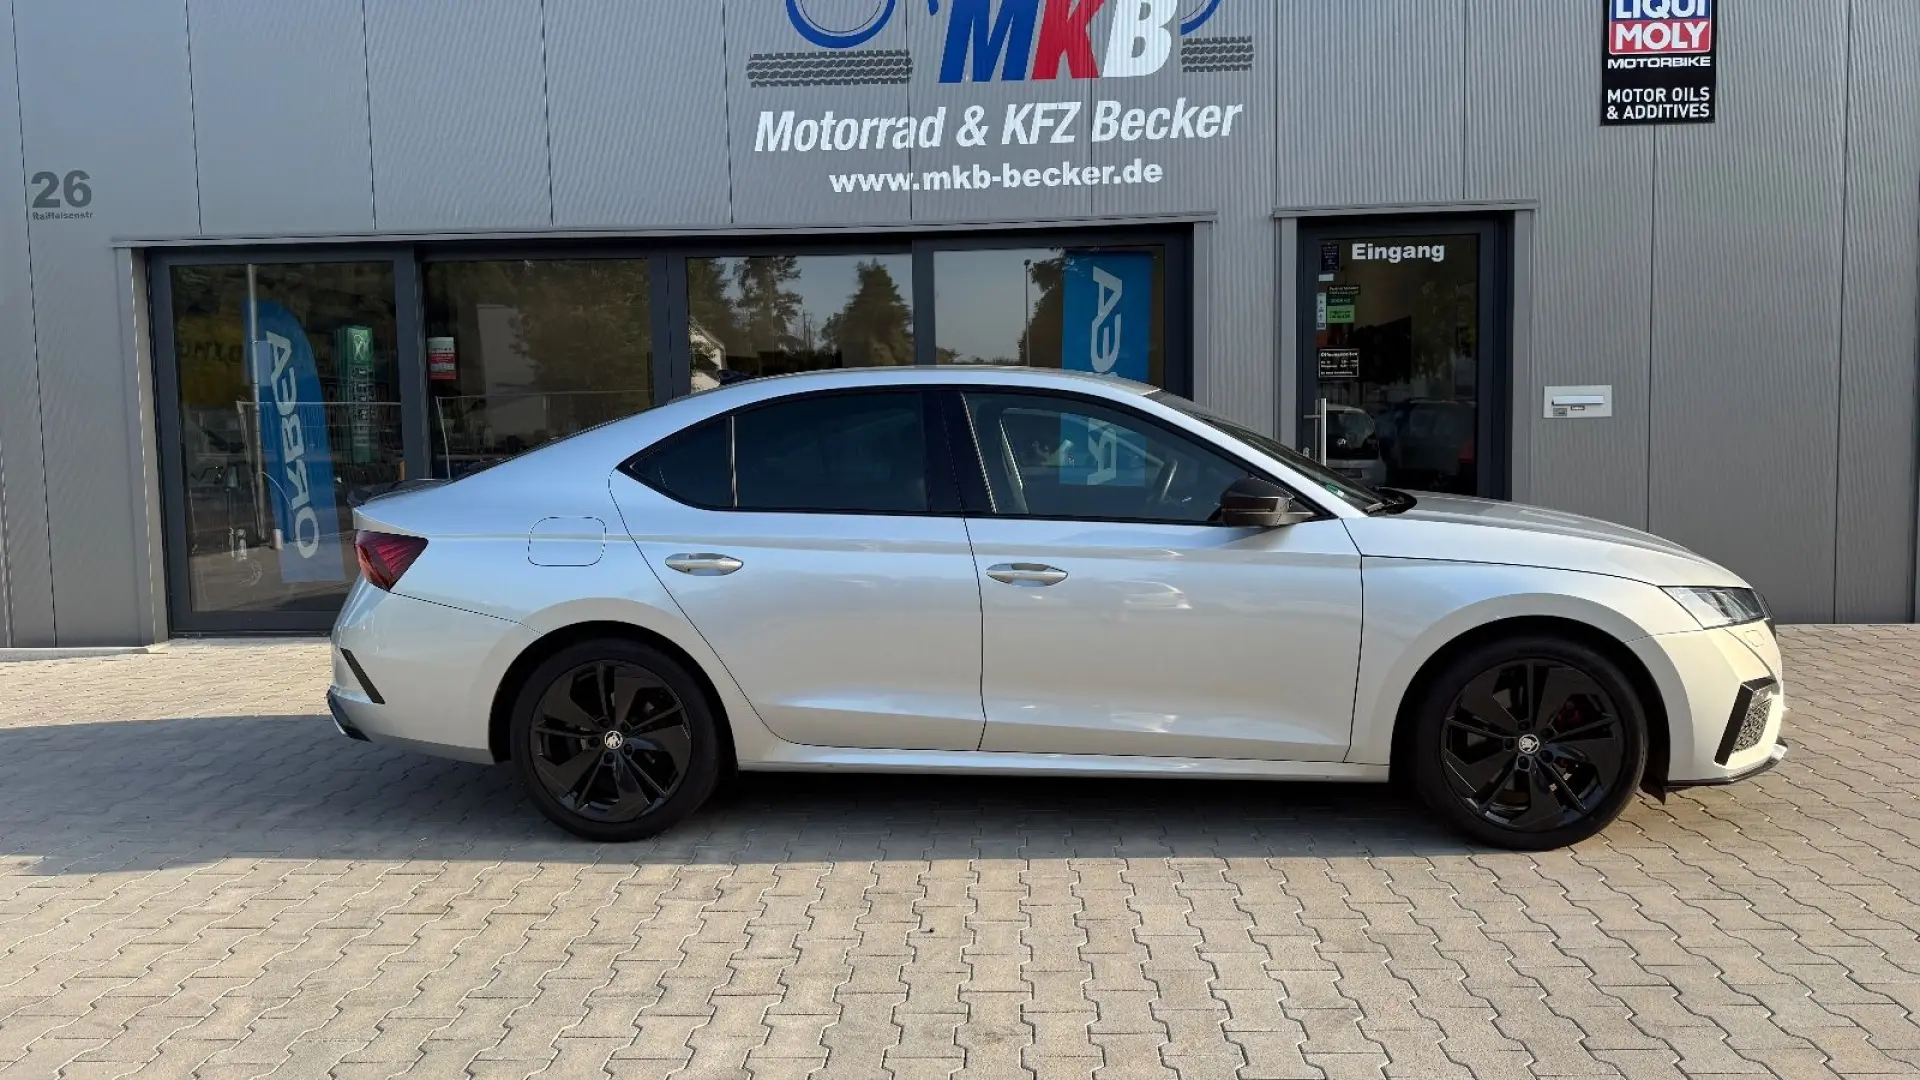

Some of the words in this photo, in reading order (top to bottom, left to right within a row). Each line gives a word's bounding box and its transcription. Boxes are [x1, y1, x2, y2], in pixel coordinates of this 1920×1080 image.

[1615, 0, 1705, 19] LIQUI
[938, 0, 1177, 83] MKB
[1615, 22, 1708, 50] MOLY
[1607, 56, 1711, 69] MOTORBIKE
[1607, 88, 1667, 103] MOTOR
[1672, 86, 1710, 102] OILS
[1606, 105, 1619, 120] &
[1622, 103, 1710, 119] ADDITIVES
[754, 106, 947, 152] Motorrad
[956, 105, 988, 146] &
[1001, 102, 1082, 145] KFZ
[1091, 98, 1243, 142] Becker
[829, 158, 1164, 193] www.mkb-becker.de
[31, 169, 92, 208] 26
[1352, 243, 1445, 263] Eingang
